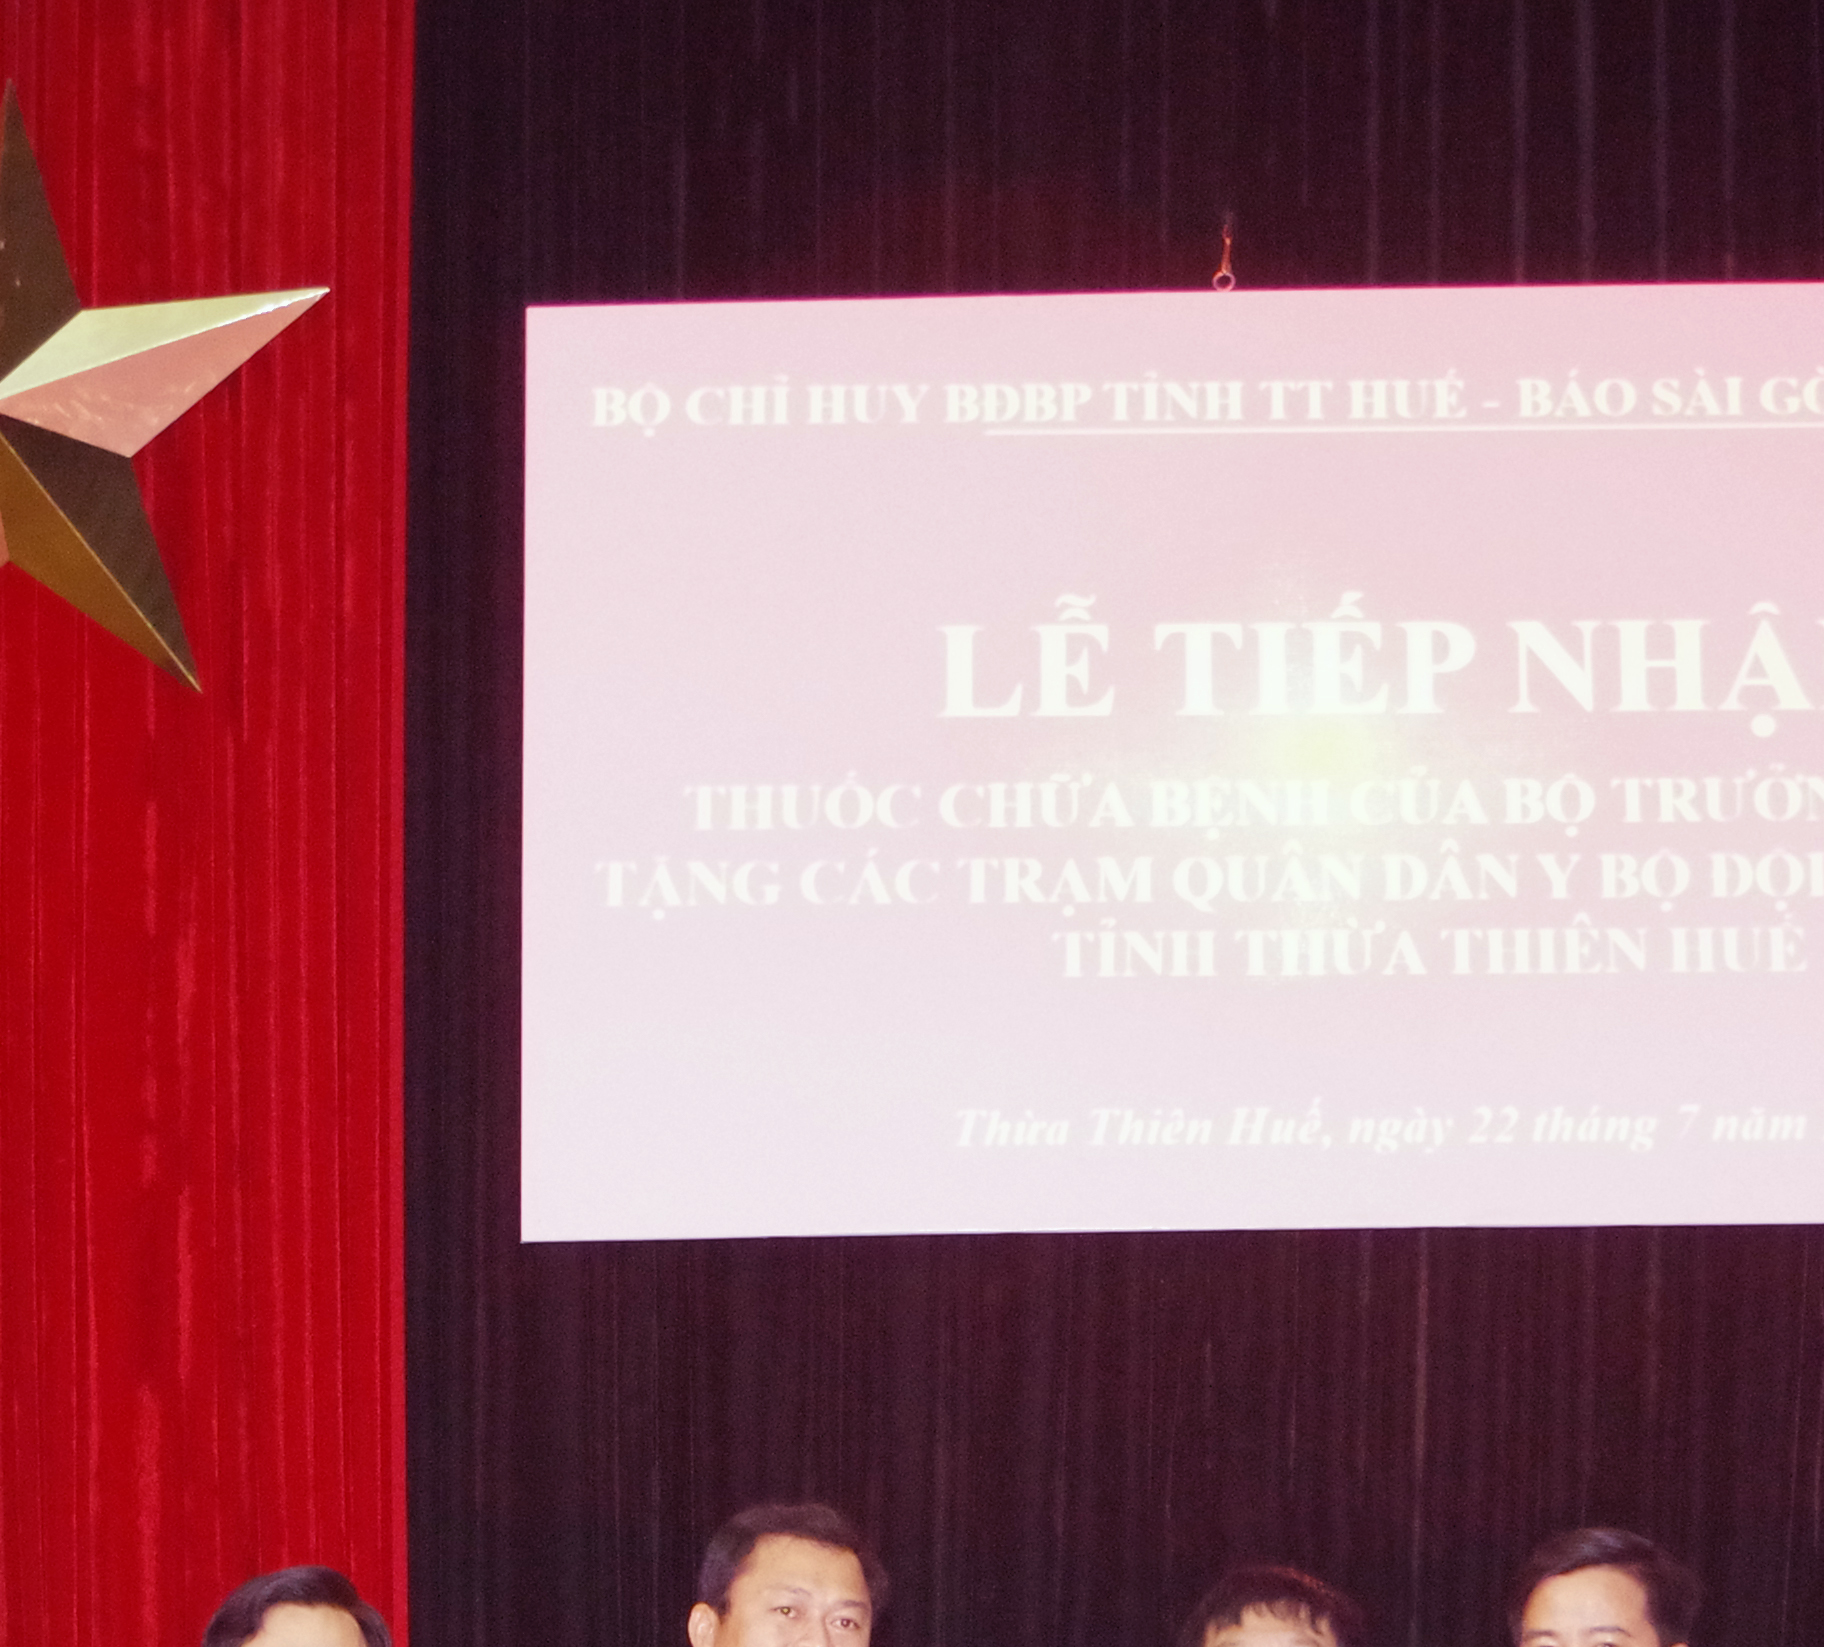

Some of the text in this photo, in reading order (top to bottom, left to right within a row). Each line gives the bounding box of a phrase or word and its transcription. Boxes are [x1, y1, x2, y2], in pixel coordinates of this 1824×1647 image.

[592, 383, 671, 436] BỘ
[685, 374, 790, 426] CHỈ
[807, 384, 928, 425] HUY
[945, 382, 1093, 423] BĐBP
[1102, 371, 1243, 421] TỈNH
[1260, 380, 1332, 420] TT
[1348, 369, 1467, 419] HUẾ
[1517, 369, 1636, 417] BÁO
[1651, 367, 1744, 416] SÀI
[936, 594, 1114, 717] LỄ
[1153, 591, 1476, 717] TIẾP
[684, 769, 921, 831] THUỐC
[939, 773, 1132, 829] CHỮA
[1148, 775, 1331, 840] BỆNH
[1349, 766, 1486, 827] CỦA
[1503, 770, 1596, 837] BỘ
[595, 855, 780, 921] TẶNG
[800, 847, 940, 906] CÁC
[958, 856, 1153, 917] TRẠM
[1172, 839, 1365, 912] QUÂN
[1383, 838, 1520, 901] DÂN
[1537, 853, 1580, 900] Y
[1601, 848, 1690, 913] BỘ
[1053, 911, 1807, 978] TỈNH THỪA THIÊN HUẾ
[955, 1106, 1069, 1148] Thừa
[1087, 1105, 1213, 1147] Thiên
[1225, 1096, 1334, 1149] Huế,
[1348, 1105, 1455, 1154] ngày
[1467, 1107, 1521, 1145] 22
[1531, 1104, 1659, 1152] tháng
[1676, 1103, 1701, 1142] 7
[1712, 1107, 1808, 1143] năm
